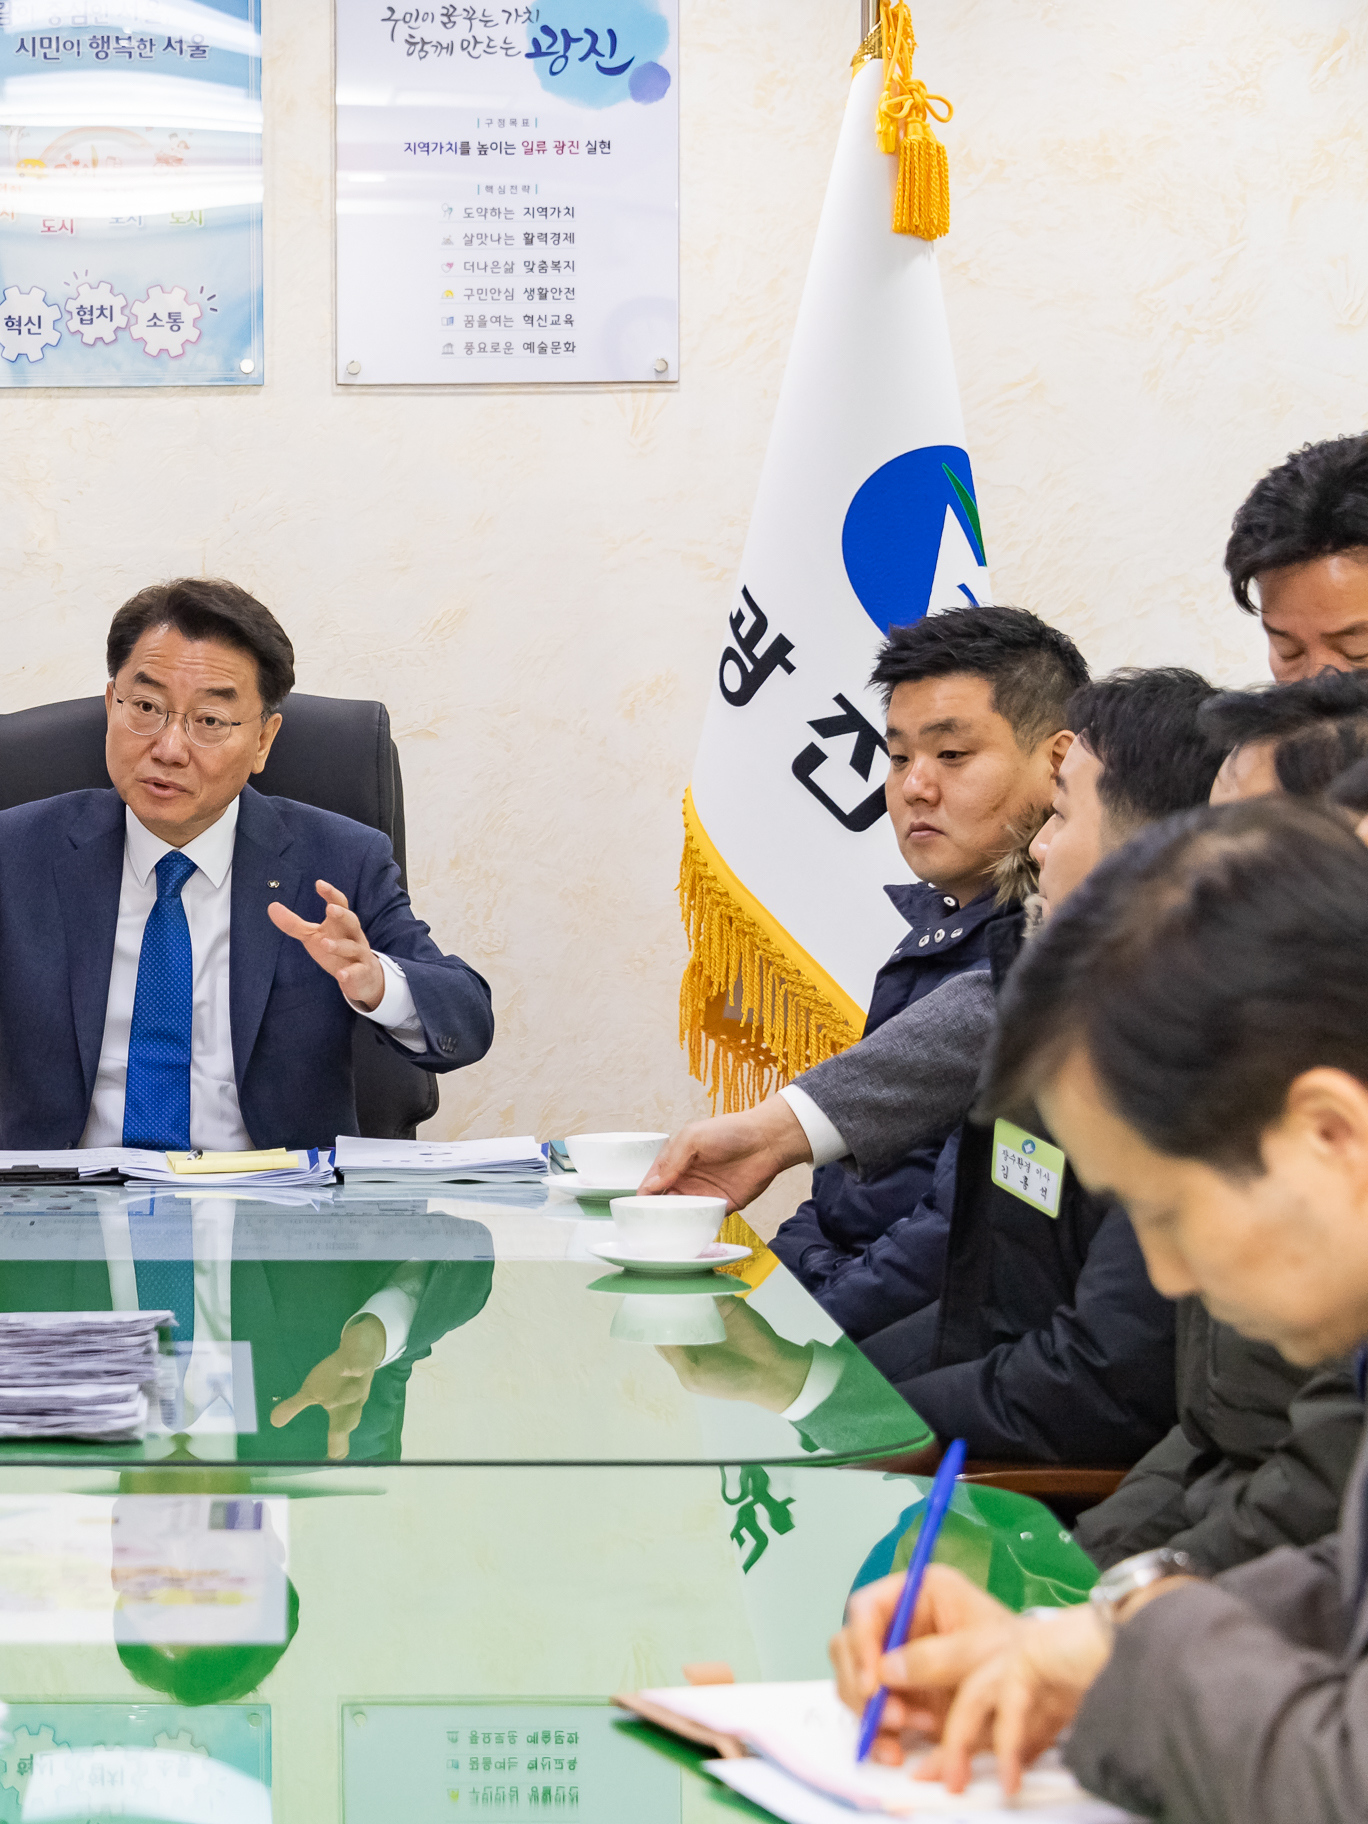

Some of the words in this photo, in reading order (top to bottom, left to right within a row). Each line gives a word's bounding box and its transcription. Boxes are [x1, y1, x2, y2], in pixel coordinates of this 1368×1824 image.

[380, 6, 435, 42] 구민이
[440, 6, 499, 33] 꿈꾸는
[501, 6, 540, 25] 가치
[15, 35, 81, 60] 시민이
[88, 35, 156, 60] 행복한
[162, 34, 210, 59] 서울
[404, 34, 454, 60] 함께
[460, 35, 521, 59] 만드는
[524, 25, 635, 76] 광진
[485, 118, 530, 128] 구정목표
[404, 141, 470, 155] 지역가치를
[477, 141, 516, 155] 높이는
[521, 141, 547, 155] 일류
[553, 141, 579, 155] 광진
[585, 140, 611, 155] 실현
[485, 185, 530, 195] 핵심전략
[463, 206, 515, 220] 도약하는
[523, 206, 576, 220] 지역가치
[40, 218, 74, 234] 도시
[463, 232, 515, 245] 살맛나는
[523, 232, 576, 245] 활력경제
[523, 260, 576, 274] 맞춤복지
[463, 287, 515, 301] 구민안심
[523, 287, 576, 301] 생활안전
[76, 304, 114, 324] 협치
[463, 314, 515, 328] 꿈을여는
[523, 314, 576, 328] 혁신교육
[4, 315, 42, 335] 혁신
[146, 311, 185, 332] 소통
[463, 341, 515, 355] 풍요로운
[523, 341, 576, 355] 예술문화
